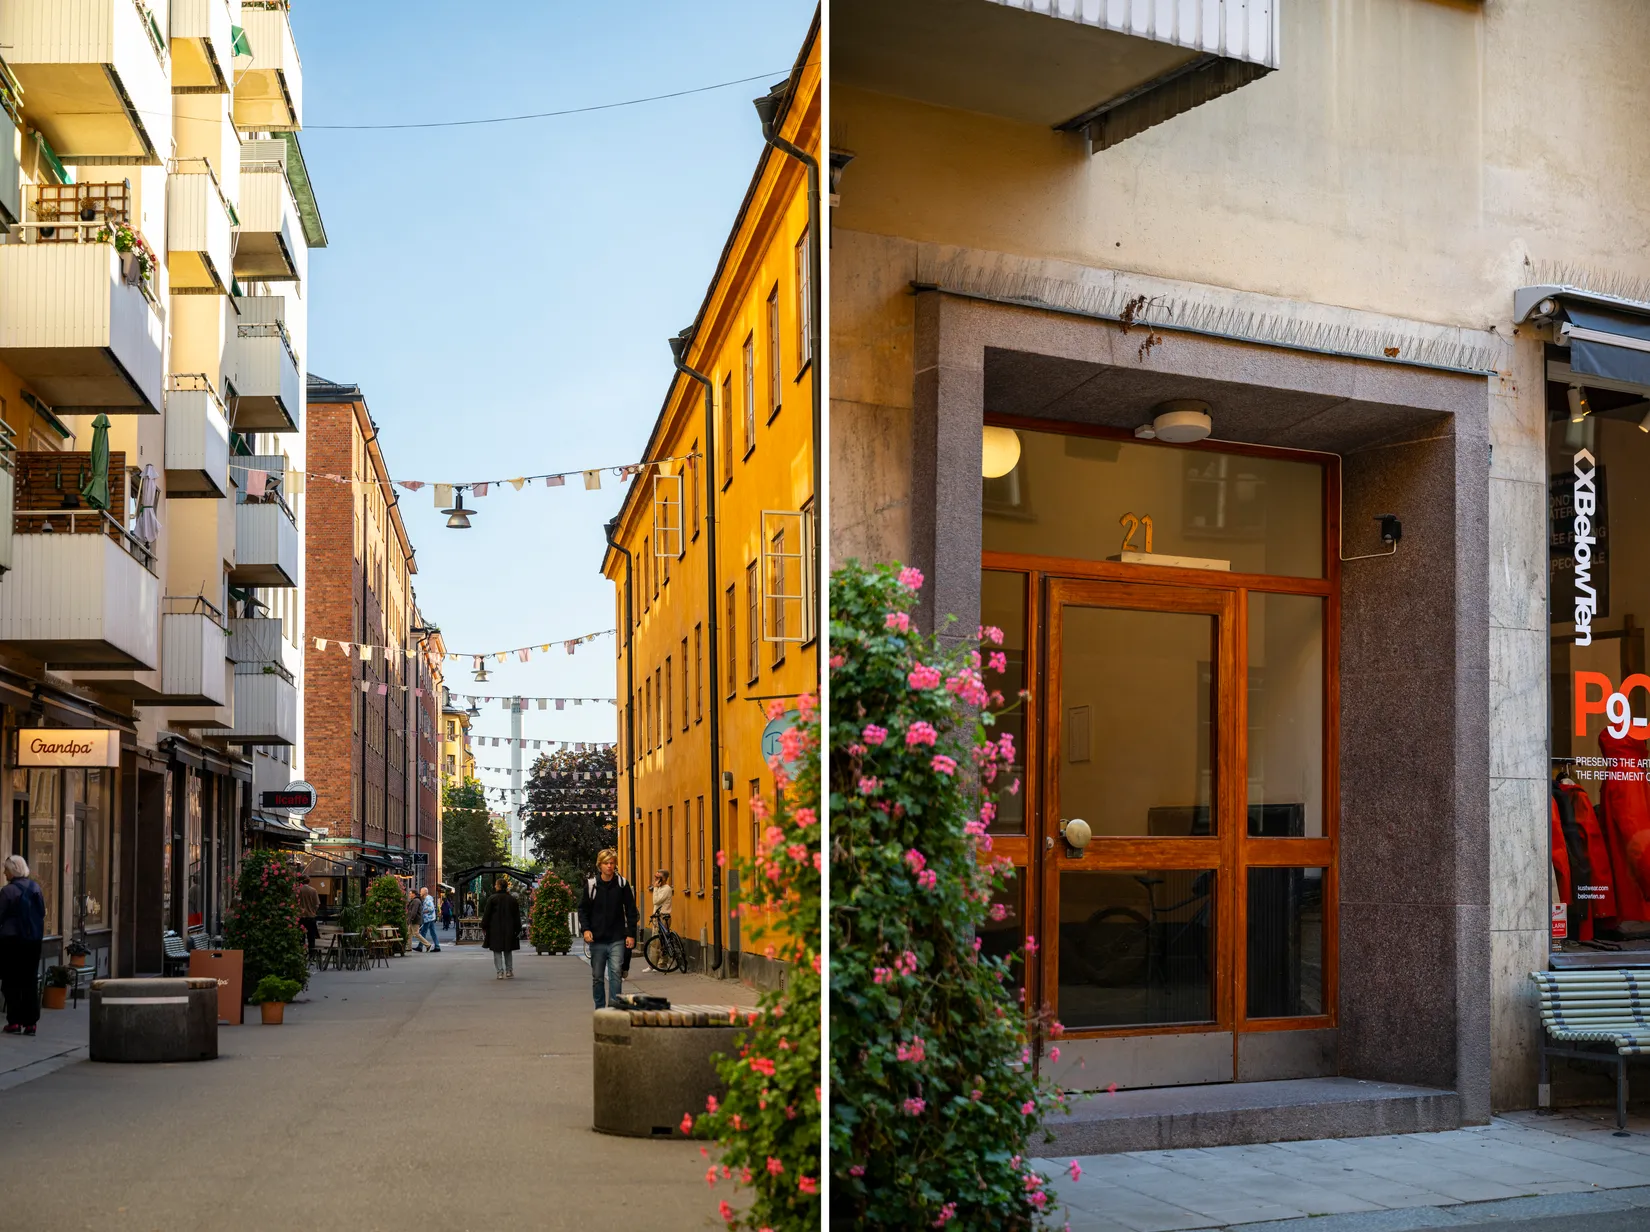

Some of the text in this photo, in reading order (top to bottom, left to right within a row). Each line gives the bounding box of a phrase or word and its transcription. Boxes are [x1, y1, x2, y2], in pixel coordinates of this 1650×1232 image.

[1119, 511, 1153, 554] 21
[30, 738, 92, 757] Grandpa
[1575, 756, 1618, 767] PRESENTS
[1620, 758, 1635, 768] THE
[1576, 770, 1592, 780] THE
[1594, 771, 1644, 781] REFINEMENT
